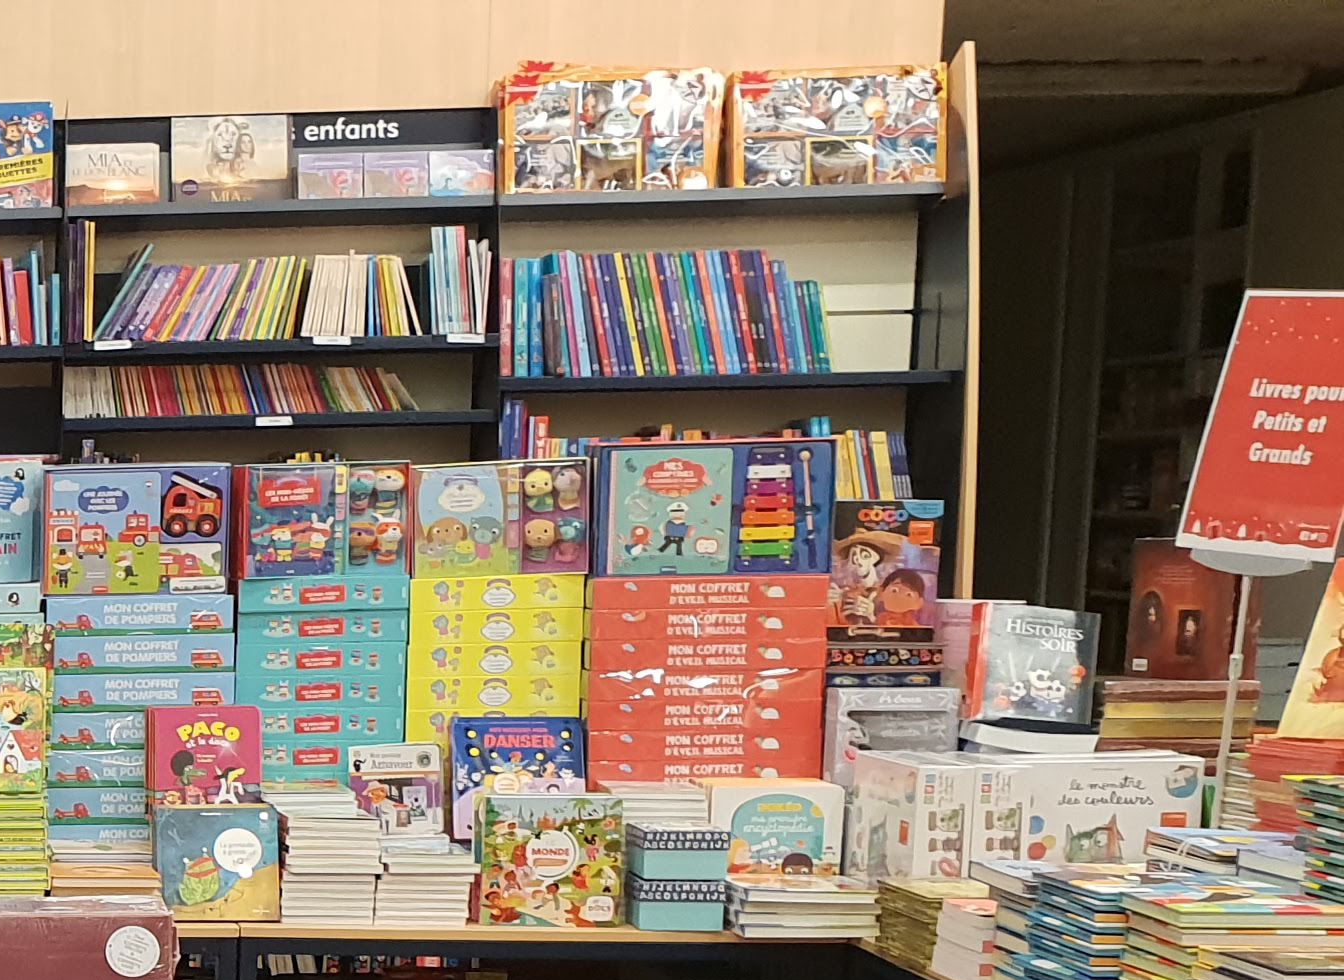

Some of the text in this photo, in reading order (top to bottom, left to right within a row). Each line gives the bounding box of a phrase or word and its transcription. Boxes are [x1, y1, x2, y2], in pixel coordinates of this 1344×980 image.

[304, 120, 399, 141] enfants
[88, 152, 123, 169] MIA
[1249, 378, 1301, 400] Livres
[1252, 410, 1327, 433] Petits et
[1248, 442, 1313, 466] Grands
[858, 508, 909, 523] COCO
[670, 582, 750, 593] MON COFFRET
[103, 602, 178, 614] MON COFFRET
[105, 614, 177, 625] DE POMPIERS
[696, 613, 747, 624] COFFRET
[1007, 618, 1084, 640] HISTOIRES
[104, 639, 180, 652] MON COFFRET
[668, 644, 747, 655] MON COFFRET
[1040, 637, 1077, 653] SOIR
[105, 651, 178, 663] DE POMPIERS
[105, 678, 181, 690] MON COFFRET
[105, 689, 178, 701] DE POMPIERS
[665, 705, 689, 715] MON
[176, 720, 241, 743] PACO
[483, 734, 556, 749] DANSER
[666, 734, 744, 745] MON COFFRET
[664, 763, 744, 775] MON COFFRET
[1069, 777, 1146, 791] le monstre
[100, 793, 129, 803] MON
[1058, 793, 1154, 807] des couleurs
[531, 848, 570, 856] MONDE
